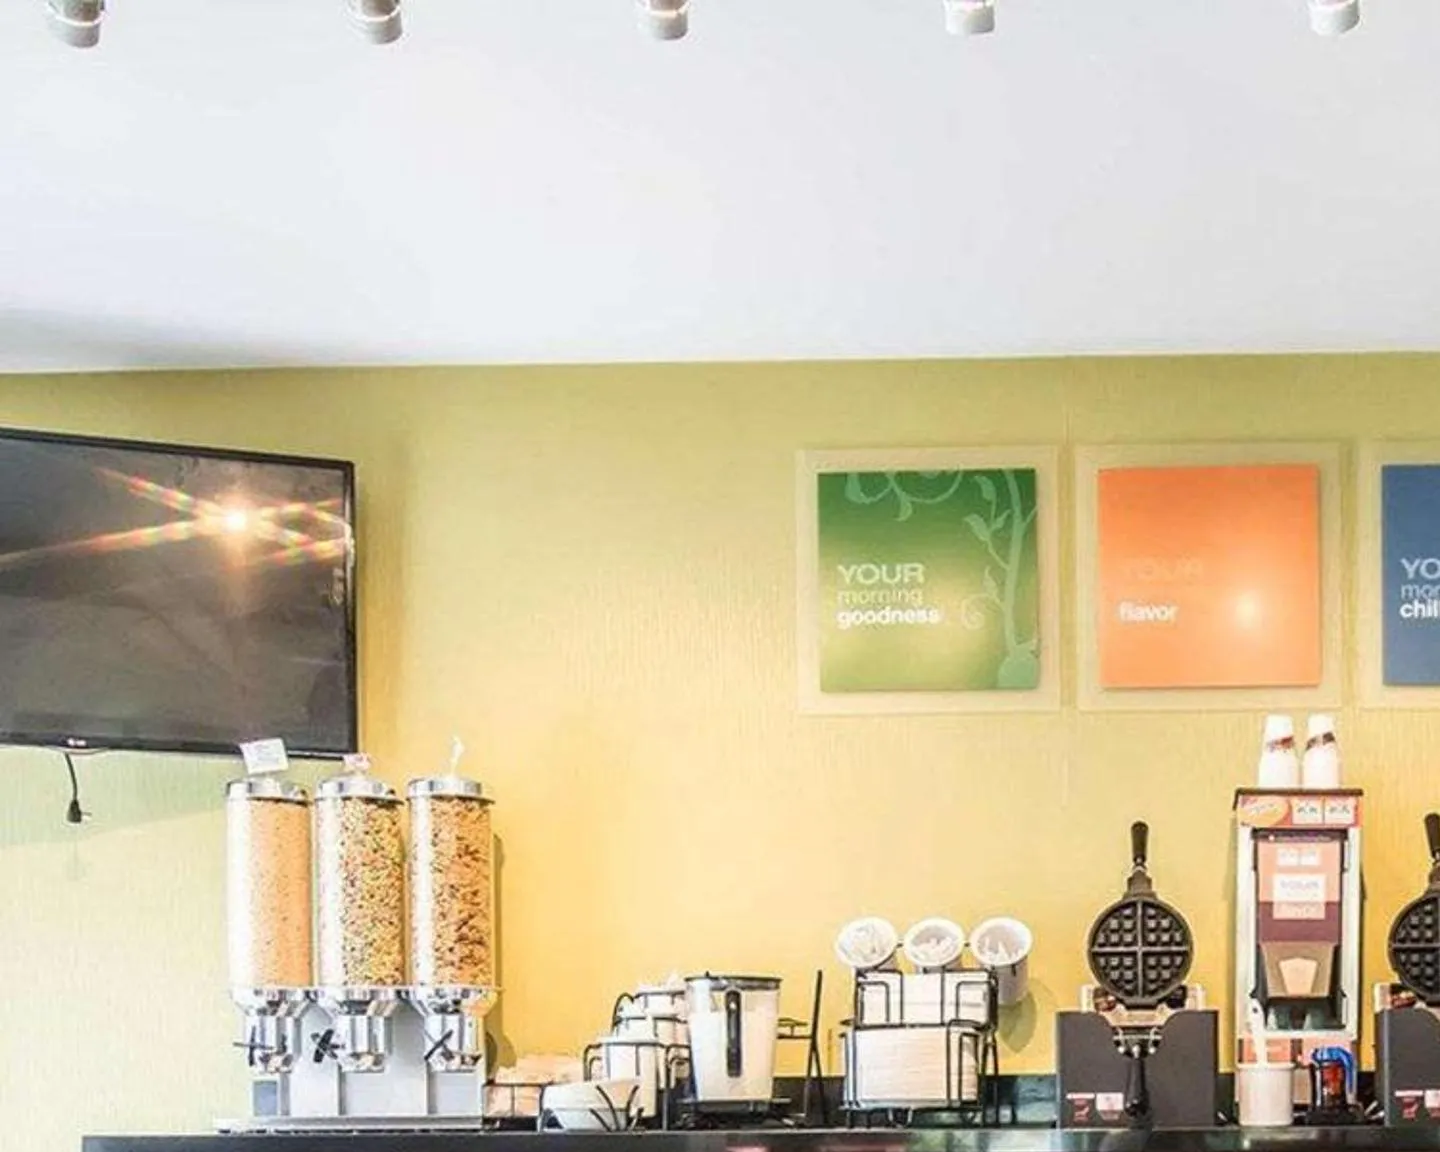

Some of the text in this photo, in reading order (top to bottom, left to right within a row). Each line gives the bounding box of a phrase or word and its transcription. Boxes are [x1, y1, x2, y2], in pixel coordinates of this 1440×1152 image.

[837, 563, 925, 585] YOUR
[837, 588, 923, 608] morning
[837, 606, 940, 629] goodness
[1119, 601, 1179, 622] flavor
